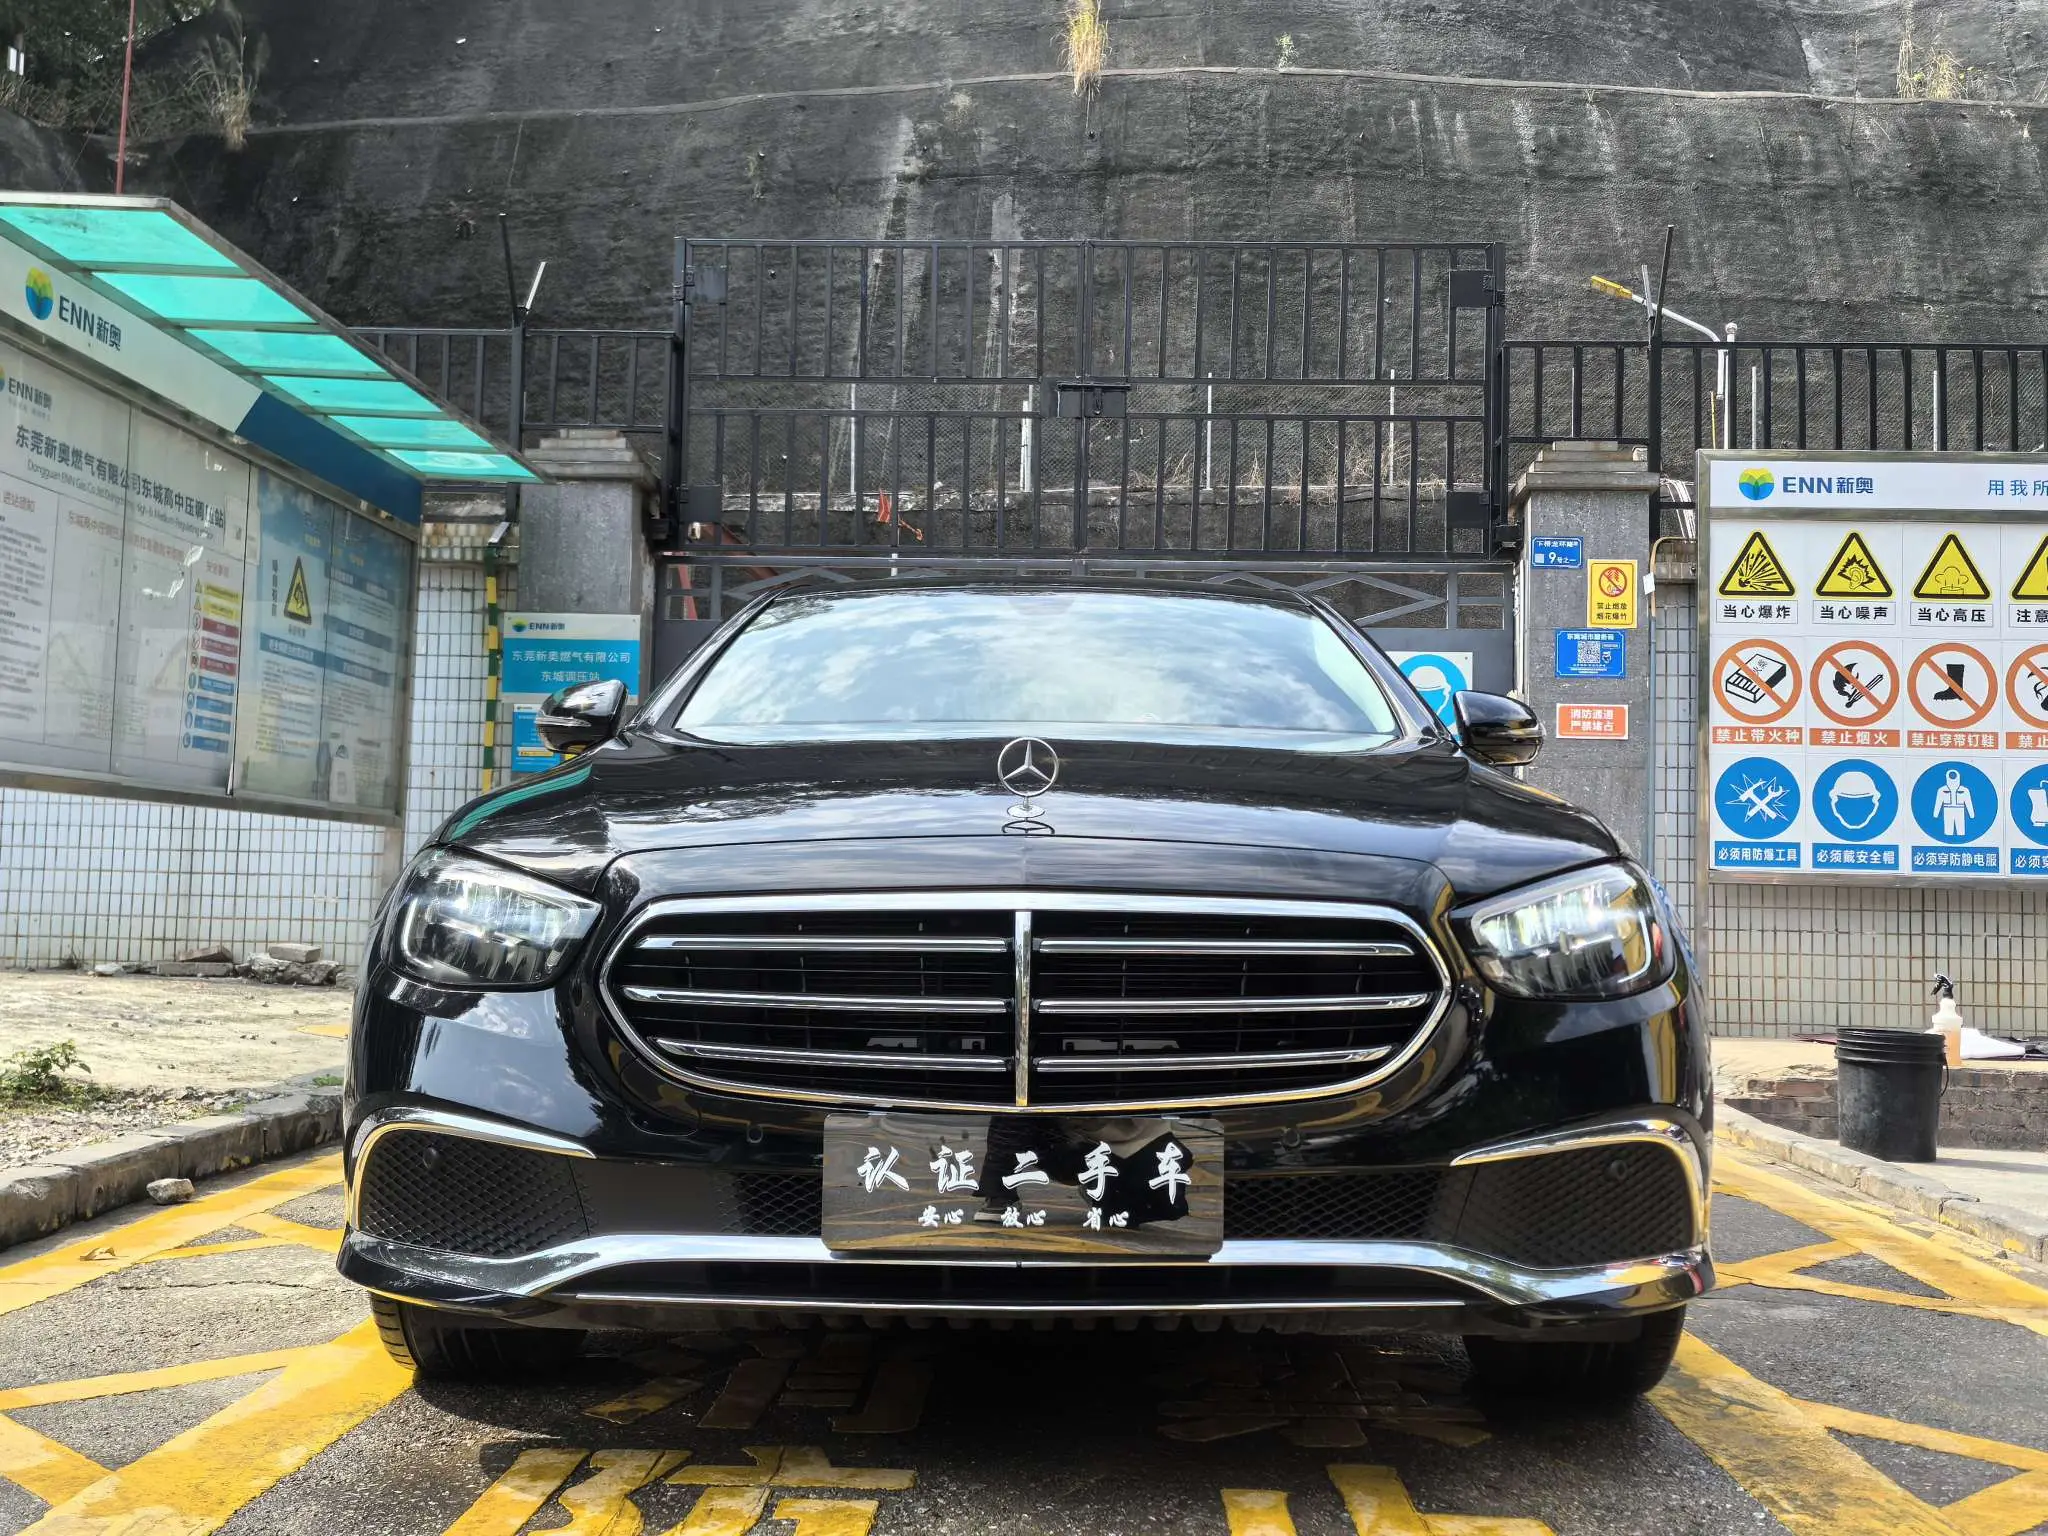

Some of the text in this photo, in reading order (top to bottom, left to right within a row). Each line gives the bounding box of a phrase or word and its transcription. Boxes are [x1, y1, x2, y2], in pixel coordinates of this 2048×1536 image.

[59, 295, 122, 351] ENN新奥
[1782, 476, 1874, 494] ENN新奥
[1987, 479, 2048, 496] 用我所
[1723, 604, 1791, 619] 当心爆炸
[1819, 605, 1889, 620] 当心噪声
[1917, 607, 1986, 623] 当心高压
[2016, 608, 2048, 623] 注意
[512, 650, 631, 664] 东莞新奥燃气有限公司
[1716, 728, 1801, 744] 禁止带火种
[1820, 730, 1888, 746] 禁止烟火
[1911, 732, 1995, 748] 禁止穿带钉鞋
[2017, 734, 2048, 749] 禁止
[1718, 847, 1798, 863] 必须用防爆工具
[1817, 849, 1896, 865] 必须戴安全帽
[1913, 852, 1997, 867] 必须穿防静电服
[857, 1140, 1192, 1206] 认证二手车
[918, 1205, 1130, 1232] 安心 放心 省心
